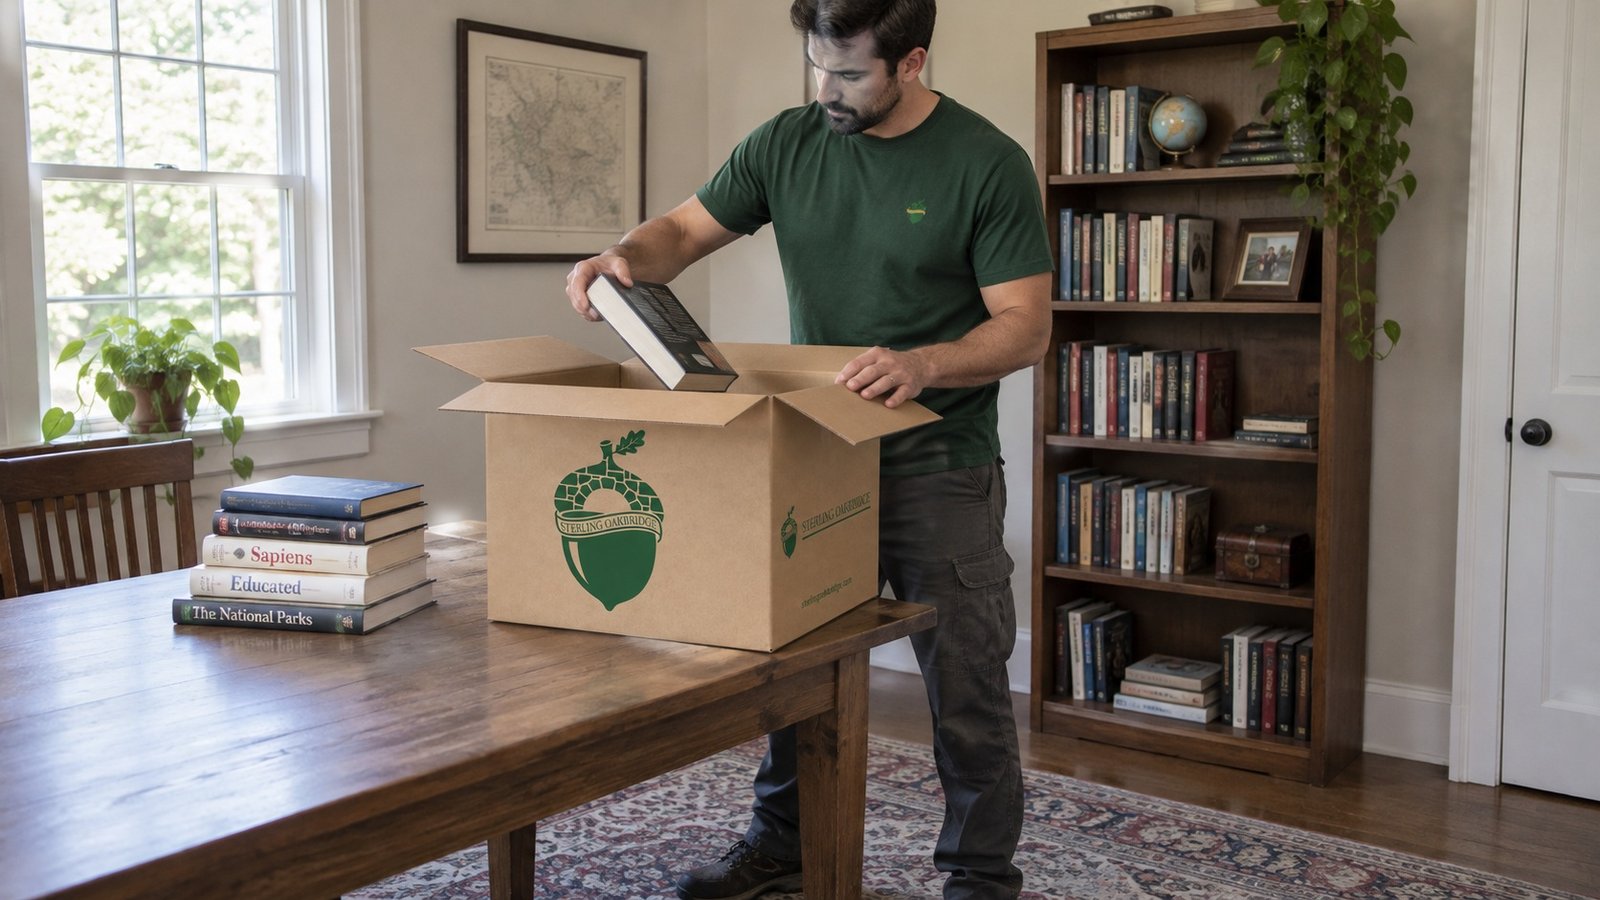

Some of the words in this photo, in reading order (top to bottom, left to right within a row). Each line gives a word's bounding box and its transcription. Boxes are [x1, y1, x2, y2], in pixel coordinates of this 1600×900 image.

[560, 520, 603, 533] STERLING
[604, 515, 657, 530] OAKBRIDGE
[801, 508, 835, 533] STERLING
[251, 546, 312, 567] Sapiens
[230, 575, 302, 596] Educated
[193, 605, 216, 620] The
[219, 607, 273, 623] National
[277, 611, 313, 626] Parks
